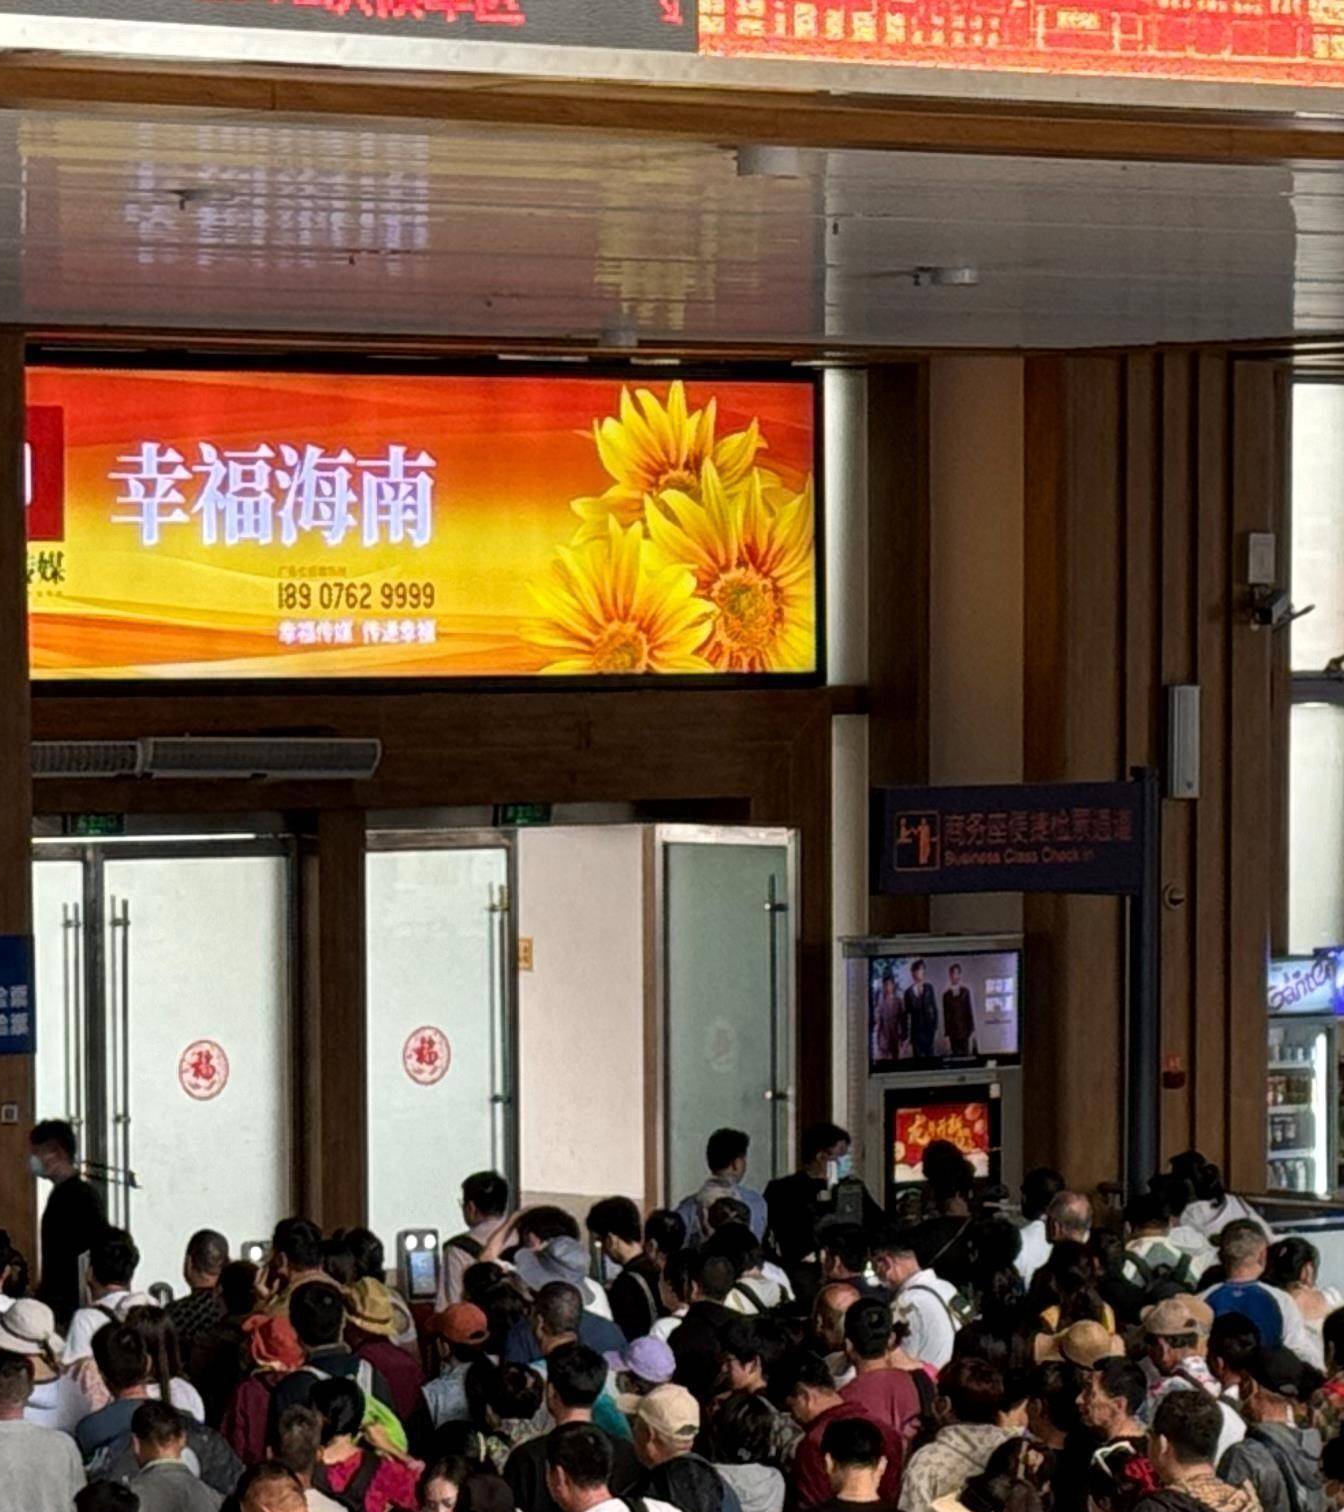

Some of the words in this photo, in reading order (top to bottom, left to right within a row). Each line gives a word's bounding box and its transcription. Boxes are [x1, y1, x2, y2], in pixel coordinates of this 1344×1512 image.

[107, 442, 438, 546] 幸福海南
[278, 582, 312, 609] 189
[319, 582, 372, 609] 0762
[380, 582, 436, 609] 9999
